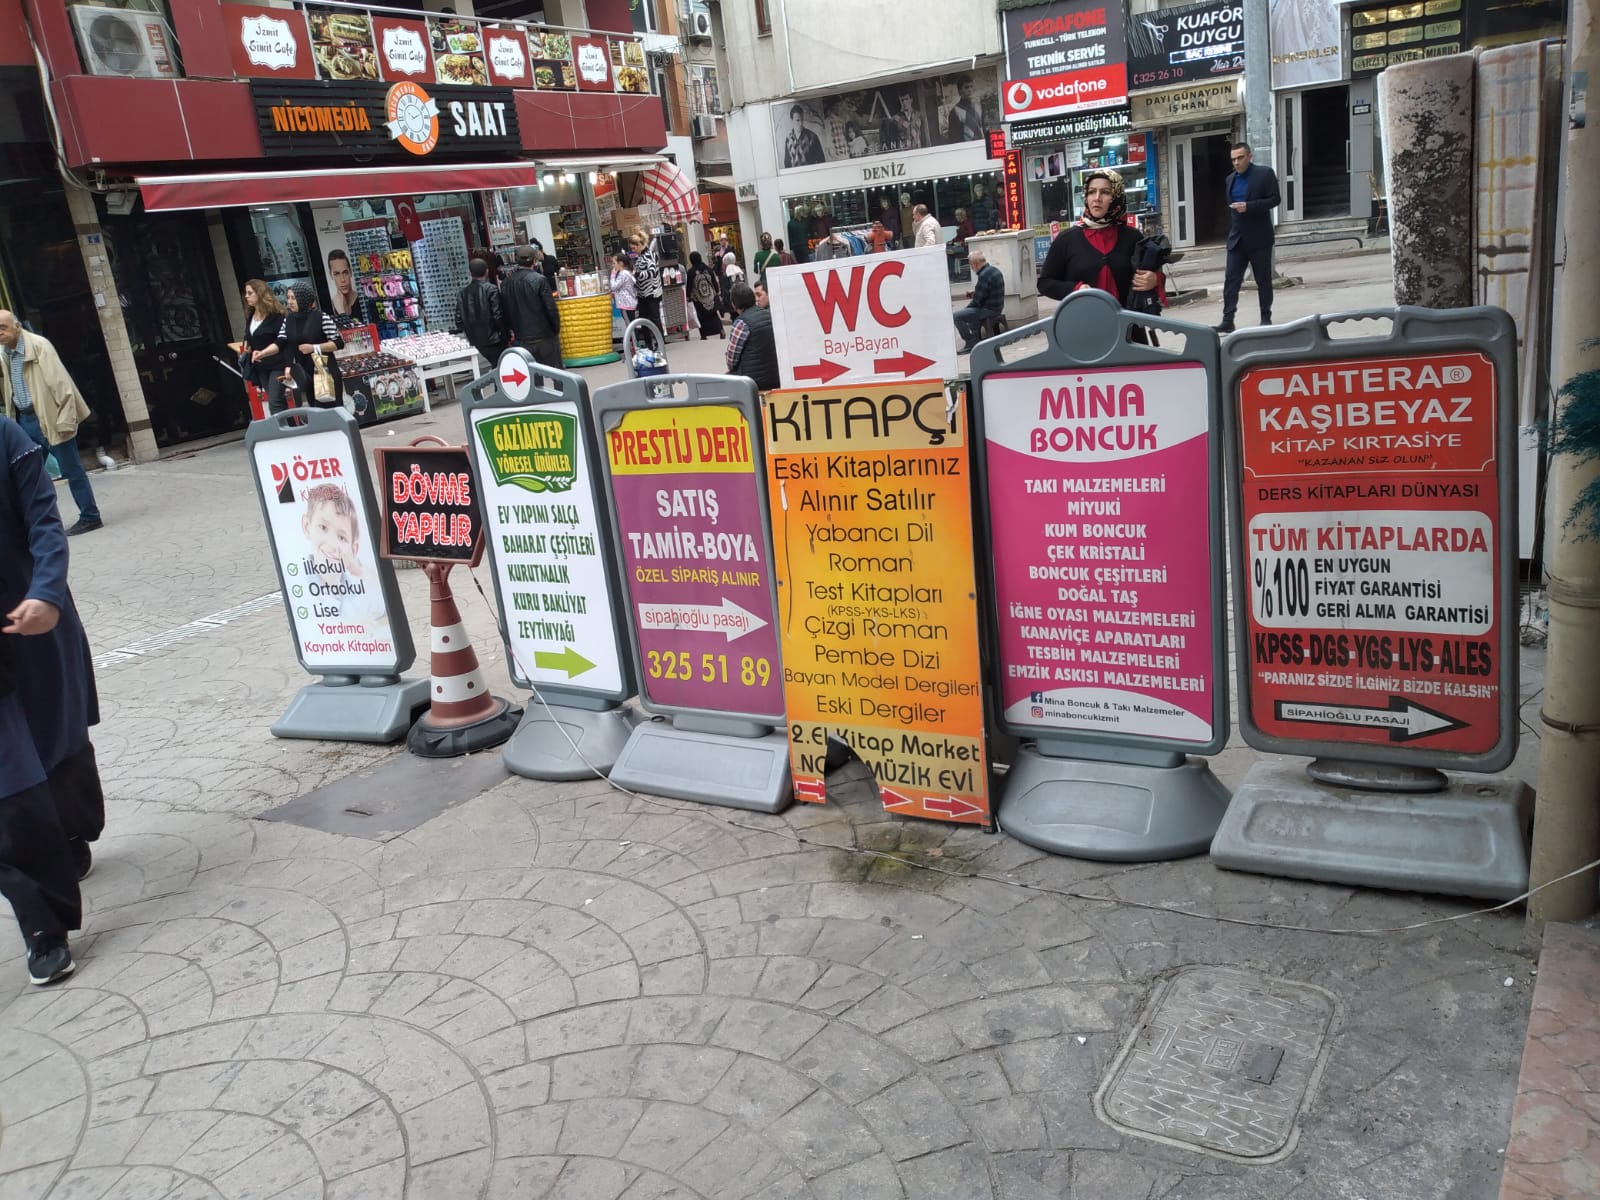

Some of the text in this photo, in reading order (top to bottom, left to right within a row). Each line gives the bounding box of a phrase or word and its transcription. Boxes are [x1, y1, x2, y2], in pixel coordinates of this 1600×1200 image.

[1023, 8, 1106, 38] VODAFONE
[1177, 5, 1243, 31] KUAFÖR
[1059, 32, 1077, 43] TÜRK
[1078, 27, 1107, 40] TELEKOM
[1180, 24, 1241, 48] DUYGU
[275, 43, 294, 56] Cafe
[1027, 43, 1106, 69] TEKNİK SERVİS
[1140, 67, 1184, 83] 325 26 10
[1036, 79, 1107, 100] vodafone
[1146, 96, 1171, 106] DAYI
[1173, 86, 1232, 102] GÜNAYDIN
[272, 99, 507, 136] NİCOMEDİA SAAT
[1168, 100, 1209, 114] İŞ HANI
[1055, 123, 1074, 136] CAM
[863, 164, 906, 180] DENİZ
[801, 260, 912, 335] WC
[824, 336, 899, 356] Bay-Bayan
[1039, 376, 1145, 420] MİNA
[1259, 397, 1473, 434] KAŞIBEYAZ
[493, 417, 564, 452] GAZİANTEP
[612, 415, 749, 466] PRESTİJ DERİ
[1030, 424, 1158, 453] BONCUK
[1271, 432, 1462, 454] KİTAP KIRTASİYE
[293, 455, 344, 481] ÖZER
[496, 453, 572, 474] YÖRESEL ÜRÜNLER
[774, 454, 960, 483] Eski Kitaplarınız
[392, 464, 471, 506] DÖVME
[1024, 473, 1166, 494] TAKI MALZEMELERİ
[1258, 482, 1480, 502] DERS KİTAPLARI DÜNYASI
[656, 488, 720, 524] SATIŞ
[800, 487, 936, 512] Alınır Satılır
[1068, 497, 1121, 516] MİYUKİ
[498, 504, 580, 530] EV YAPIMI SALÇA
[392, 511, 472, 548] YAPILIR
[806, 522, 934, 543] Yabancı Dil
[1044, 524, 1148, 538] KUM BONCUK
[1252, 521, 1488, 553] TÜM KİTAPLARDA
[502, 532, 596, 560] BAHARAT ÇEŞİTLERİ
[628, 525, 760, 563] TAMİR-BOYA
[1047, 542, 1146, 564] ÇEK KRİSTALİ
[302, 558, 346, 576] İlkokul
[507, 564, 571, 584] KURUTMALIK
[829, 552, 913, 573] Roman
[635, 566, 760, 588] ÖZEL SİPARİŞ ALINIR
[1028, 565, 1168, 586] BONCUK ÇEŞİTLERİ
[308, 579, 366, 598] Ortaokul
[806, 581, 943, 606] Test Kitapları
[1058, 584, 1139, 608] DOĞAL TAŞ
[1254, 558, 1392, 619] %100 EN UYGUN
[1314, 577, 1442, 600] FİYAT GARANTİSİ
[314, 603, 340, 619] Lise
[512, 592, 588, 615] KURU BAKLİYAT
[828, 606, 921, 622] (KPSS-YKS-LKS)
[1009, 602, 1196, 628] İĞNE OYASI MALZEMELERİ
[1316, 600, 1490, 625] GERİ ALMA GARANTİSİ
[318, 622, 366, 635] Yardımcı
[518, 618, 576, 643] ZEYTİNYAĞI
[644, 605, 750, 632] sipahioğlu pasajı
[804, 616, 948, 640] Çizgi Roman
[304, 640, 346, 656] Kaynak
[1020, 625, 1186, 649] KANAVİÇE APARATLARI
[648, 650, 771, 688] 325 51 89
[815, 645, 940, 670] Pembe Dizi
[1026, 644, 1180, 670] TESBİH MALZEMELERİ
[784, 668, 980, 698] Bayan Model Dergileri
[1008, 662, 1206, 693] EMZİK ASKISI MALZEMELERİ
[1318, 671, 1353, 689] SİZDE
[1356, 673, 1400, 693] İLGİNİZ
[1403, 676, 1441, 695] BİZDE
[816, 694, 946, 725] Eski Dergiler
[1044, 696, 1186, 718] Mina Boncuk & Takı Malzemeler
[1044, 710, 1120, 724] minaboncukizmit
[1286, 707, 1410, 727] SİPAHİOĞLU PASAJI
[901, 734, 980, 762] Market
[866, 758, 974, 793] MÜZİK EVİ
